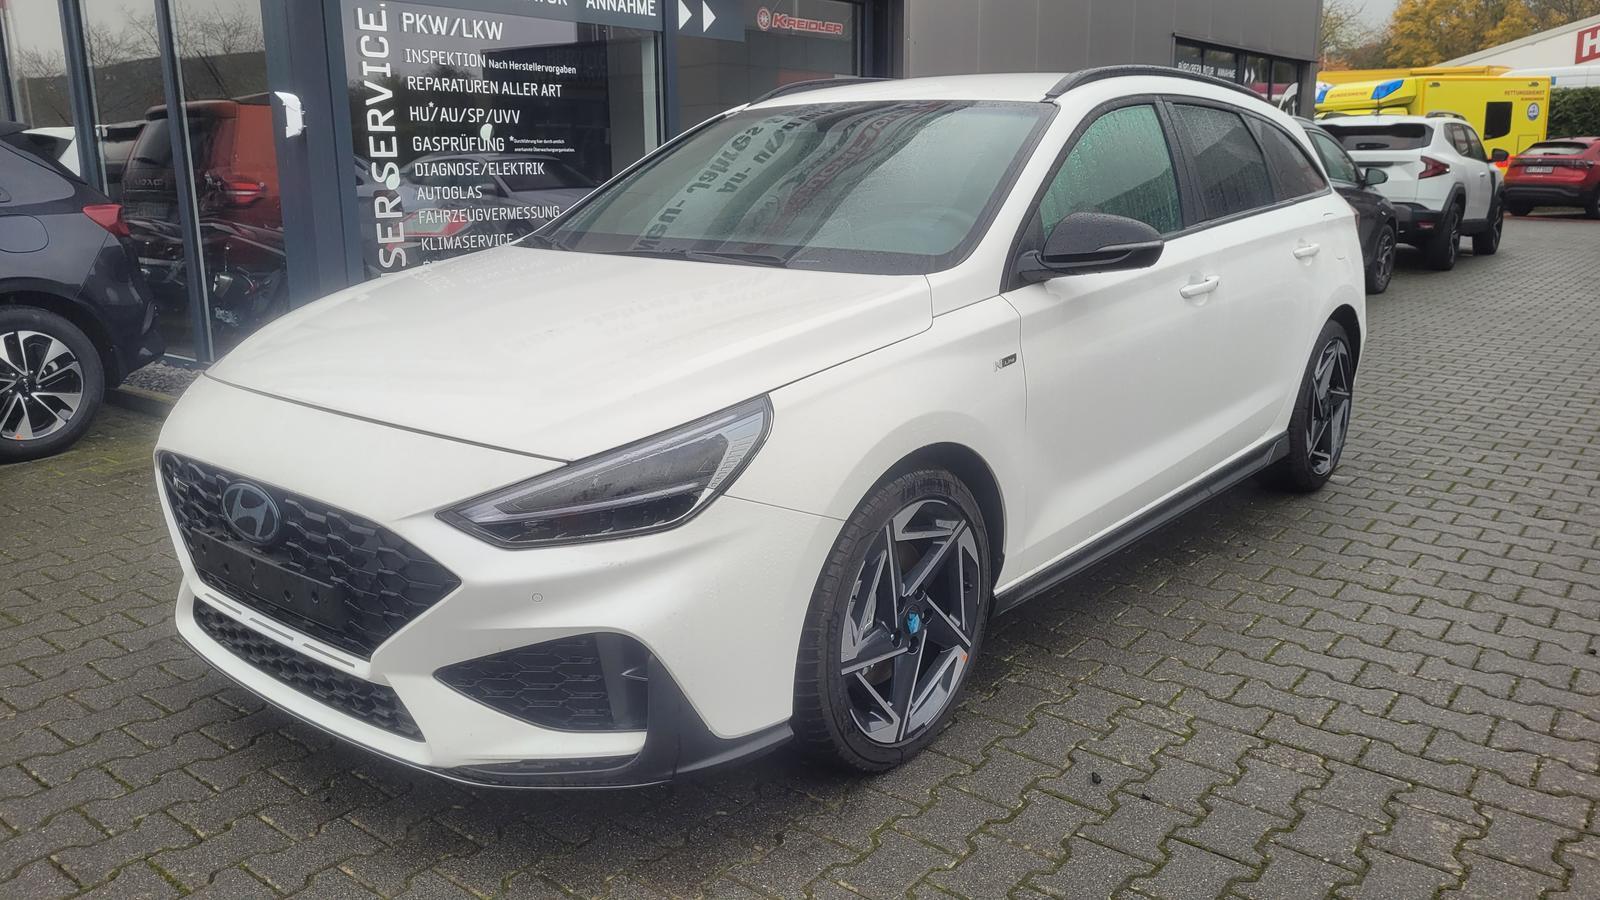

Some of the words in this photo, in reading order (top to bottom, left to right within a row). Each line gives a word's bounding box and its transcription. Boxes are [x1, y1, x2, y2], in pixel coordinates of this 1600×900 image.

[586, 0, 656, 17] ANNAHME
[402, 12, 503, 41] PKW/LKW
[772, 12, 843, 35] KREIDLER
[406, 48, 486, 68] INSPEKTION
[488, 59, 508, 70] Nach
[509, 60, 577, 75] Herstellervorgaben
[407, 76, 499, 94] REPARATUREN
[501, 81, 538, 96] ALLER
[541, 83, 562, 98] ART
[412, 134, 505, 152] GASPRÜFUNG
[415, 162, 545, 177] DIAGNOSE/ELEKTRIK
[417, 185, 483, 200] AUTOGLAS
[418, 205, 560, 224] FAHRZEUGVERMESSUNG
[421, 233, 514, 251] KLIMASERVICE
